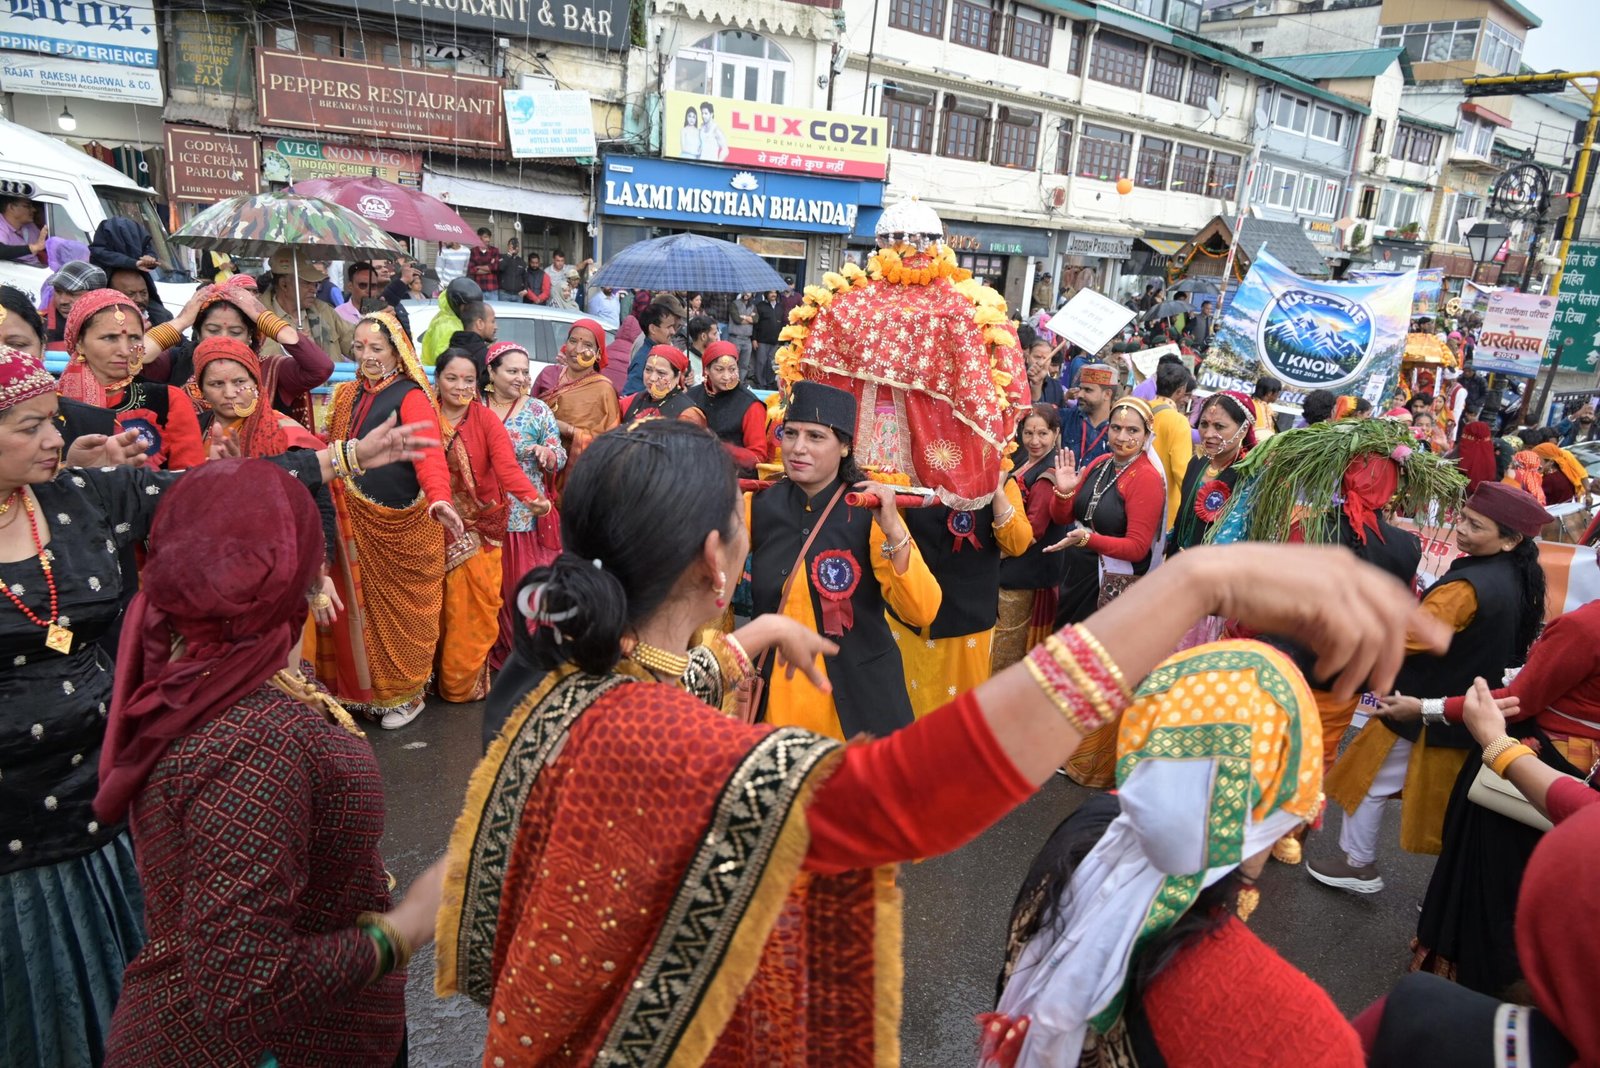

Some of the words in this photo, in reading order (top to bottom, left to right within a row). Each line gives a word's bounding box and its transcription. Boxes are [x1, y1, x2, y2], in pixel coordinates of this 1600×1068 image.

[537, 0, 556, 27] &
[563, 4, 614, 37] BAR
[56, 43, 154, 65] EXPERIENCE
[4, 67, 34, 78] RAJAT
[40, 71, 77, 82] RAKESH
[80, 75, 124, 87] AGARWAL
[128, 79, 136, 89] &
[196, 64, 223, 76] STD
[41, 80, 76, 89] Chartered
[78, 83, 122, 93] Accountants
[194, 74, 223, 87] FAX
[269, 73, 361, 100] PEPPERS
[367, 86, 495, 115] RESTAURANT
[319, 100, 374, 113] BREAKFAST
[380, 106, 412, 118] LUNCH
[419, 111, 453, 121] DINNER
[352, 117, 389, 128] LIBRARY
[391, 121, 423, 131] CHOWK
[731, 111, 803, 137] LUX
[809, 120, 879, 147] COZI
[184, 139, 242, 155] GODIYAL
[283, 141, 319, 157] VEG
[326, 146, 364, 162] NON
[368, 151, 401, 166] VEG
[766, 138, 813, 149] PREMIUM
[818, 144, 846, 153] WEAR
[179, 152, 201, 164] ICE
[203, 155, 248, 168] CREAM
[299, 159, 336, 171] INDIAN
[339, 163, 387, 178] CHINESE
[757, 152, 768, 163] ये
[769, 153, 788, 166] नहीं
[790, 155, 802, 167] तो
[804, 158, 825, 171] कुछ
[826, 160, 846, 172] नहीं
[185, 166, 244, 180] PARLOUR
[181, 185, 217, 194] LIBRARY
[606, 180, 673, 210] LAXMI
[677, 186, 765, 221] MISTHAN
[769, 196, 858, 227] BHANDAR
[1582, 251, 1598, 267] रोड
[1505, 307, 1529, 317] पालिका
[1480, 330, 1542, 353] शरदोत्सव
[1279, 352, 1286, 363] I
[1287, 354, 1339, 375] KNOW
